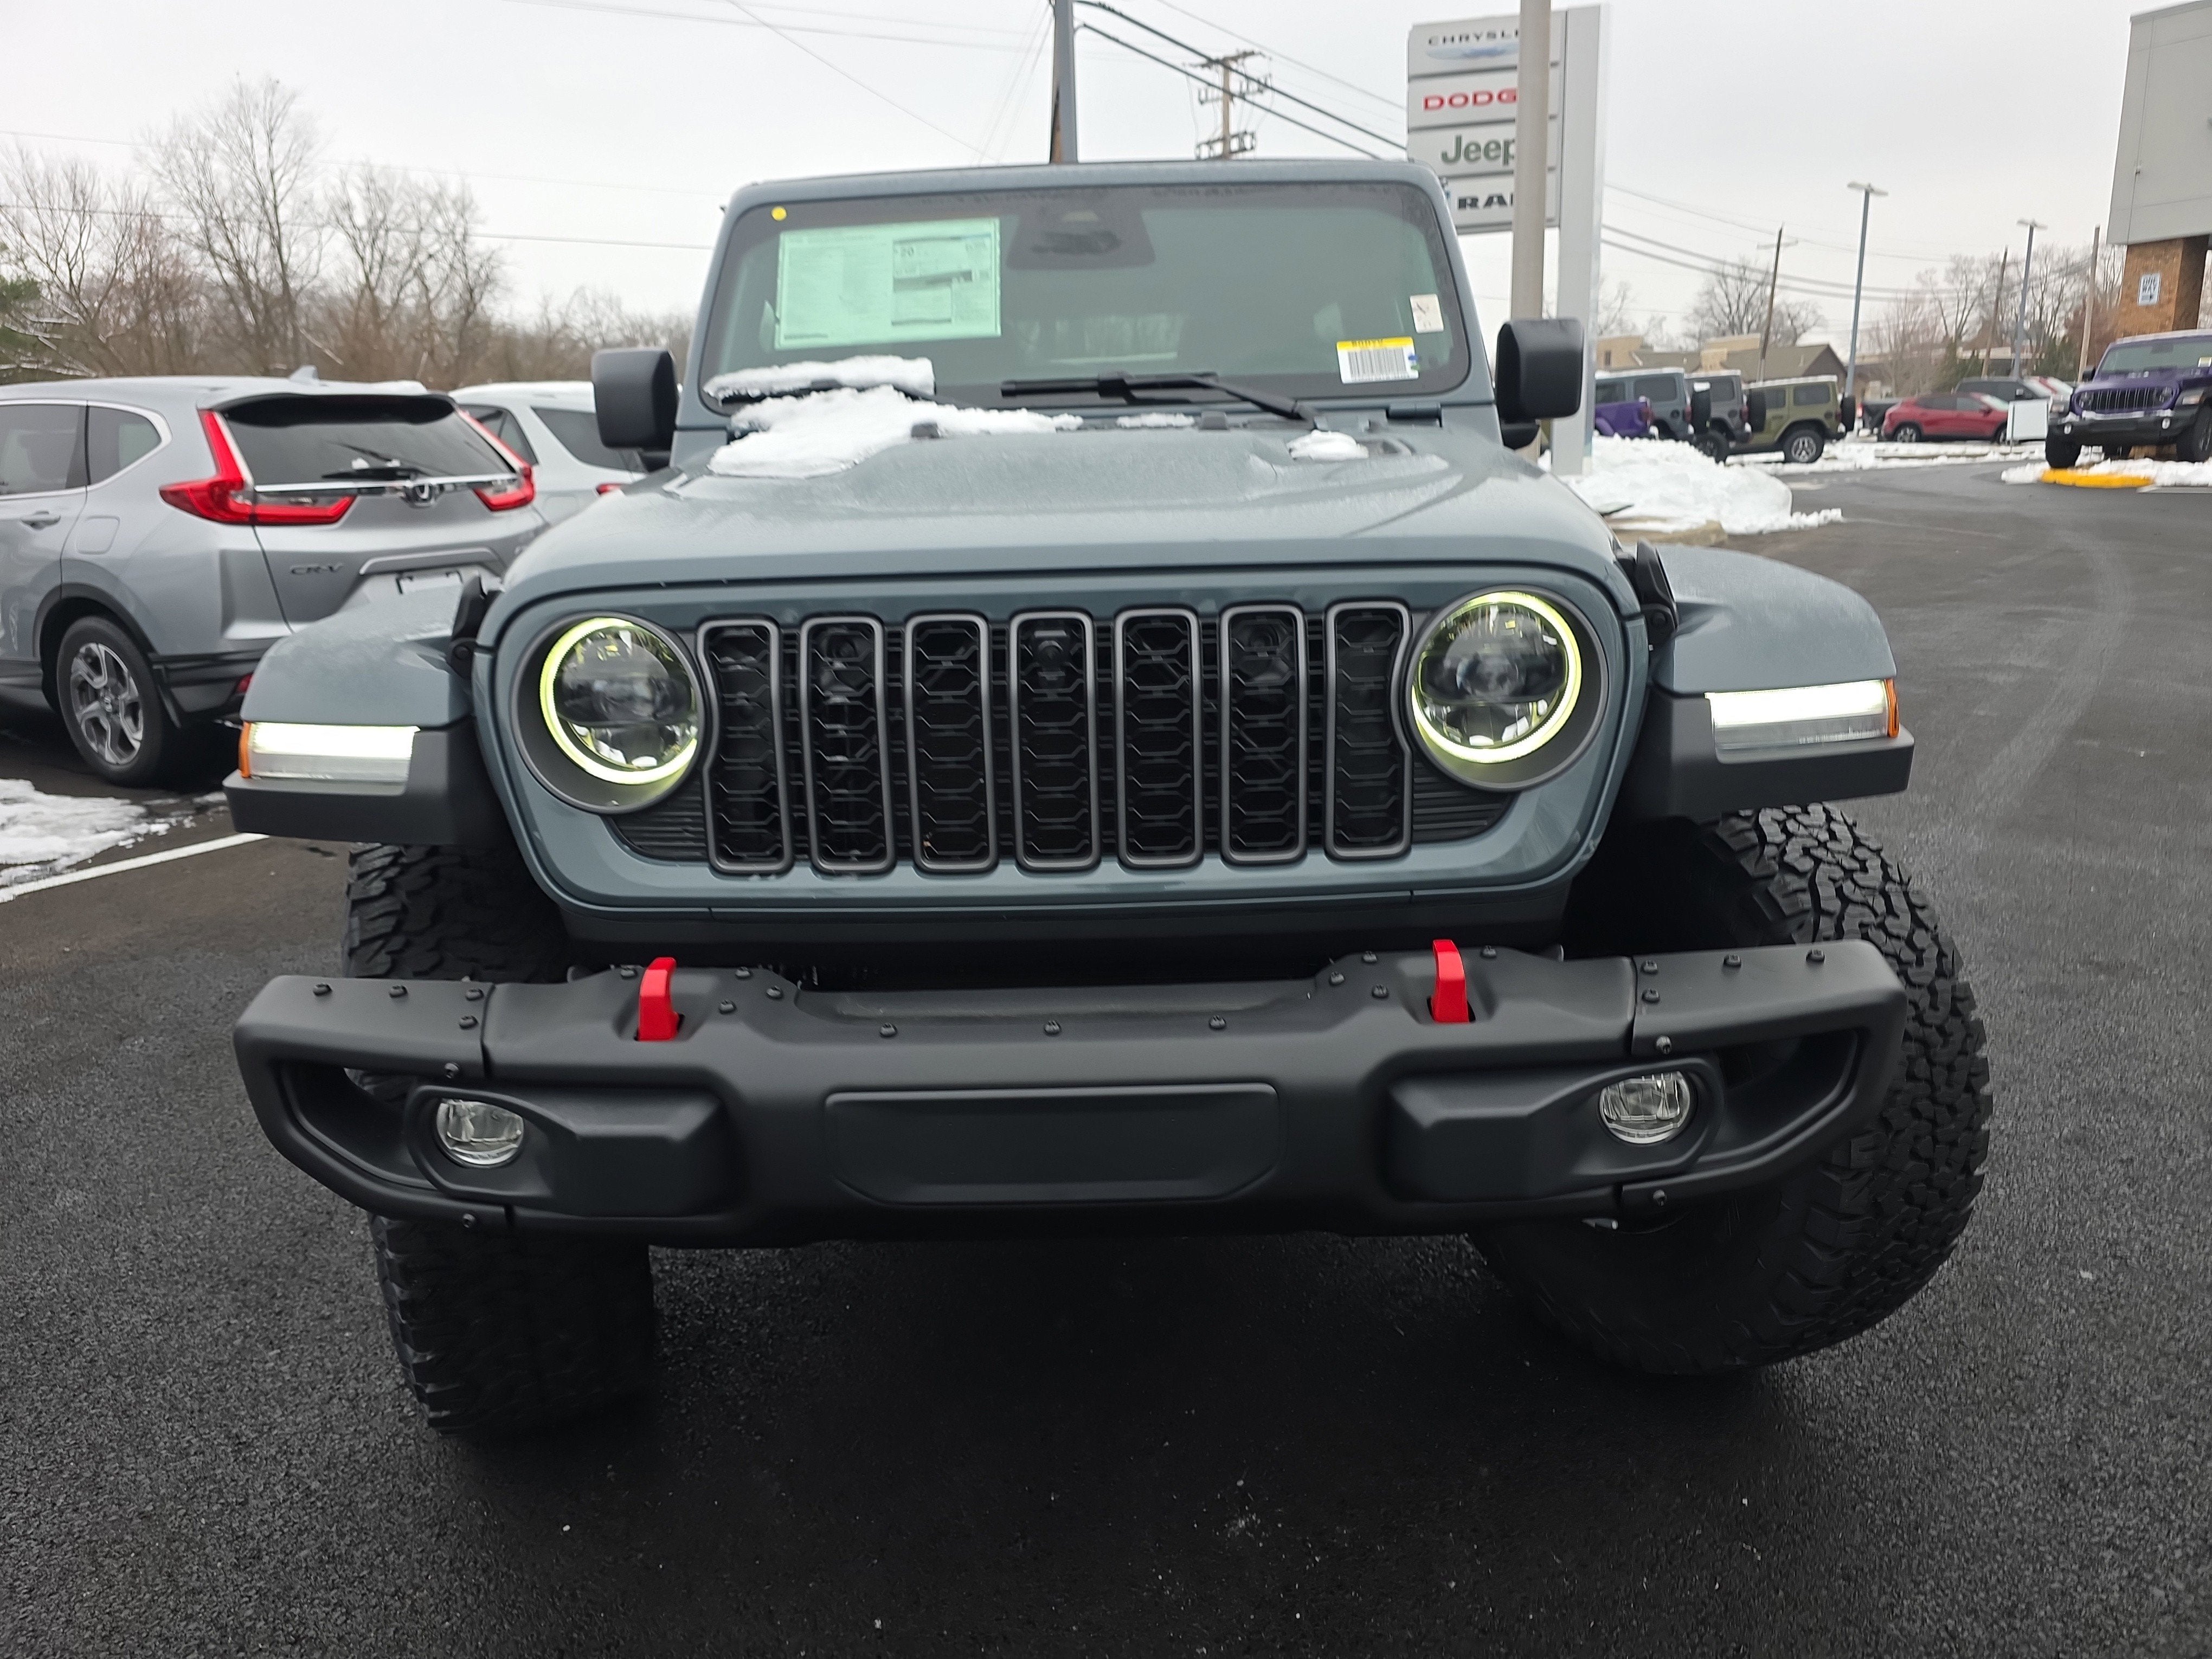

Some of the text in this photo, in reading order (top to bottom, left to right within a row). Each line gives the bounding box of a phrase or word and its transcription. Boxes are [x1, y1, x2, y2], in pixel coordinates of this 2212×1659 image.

[1428, 29, 1518, 46] CHRYSL
[1423, 88, 1516, 110] DODG
[1458, 192, 1514, 210] RA
[290, 564, 344, 575] CR-V
